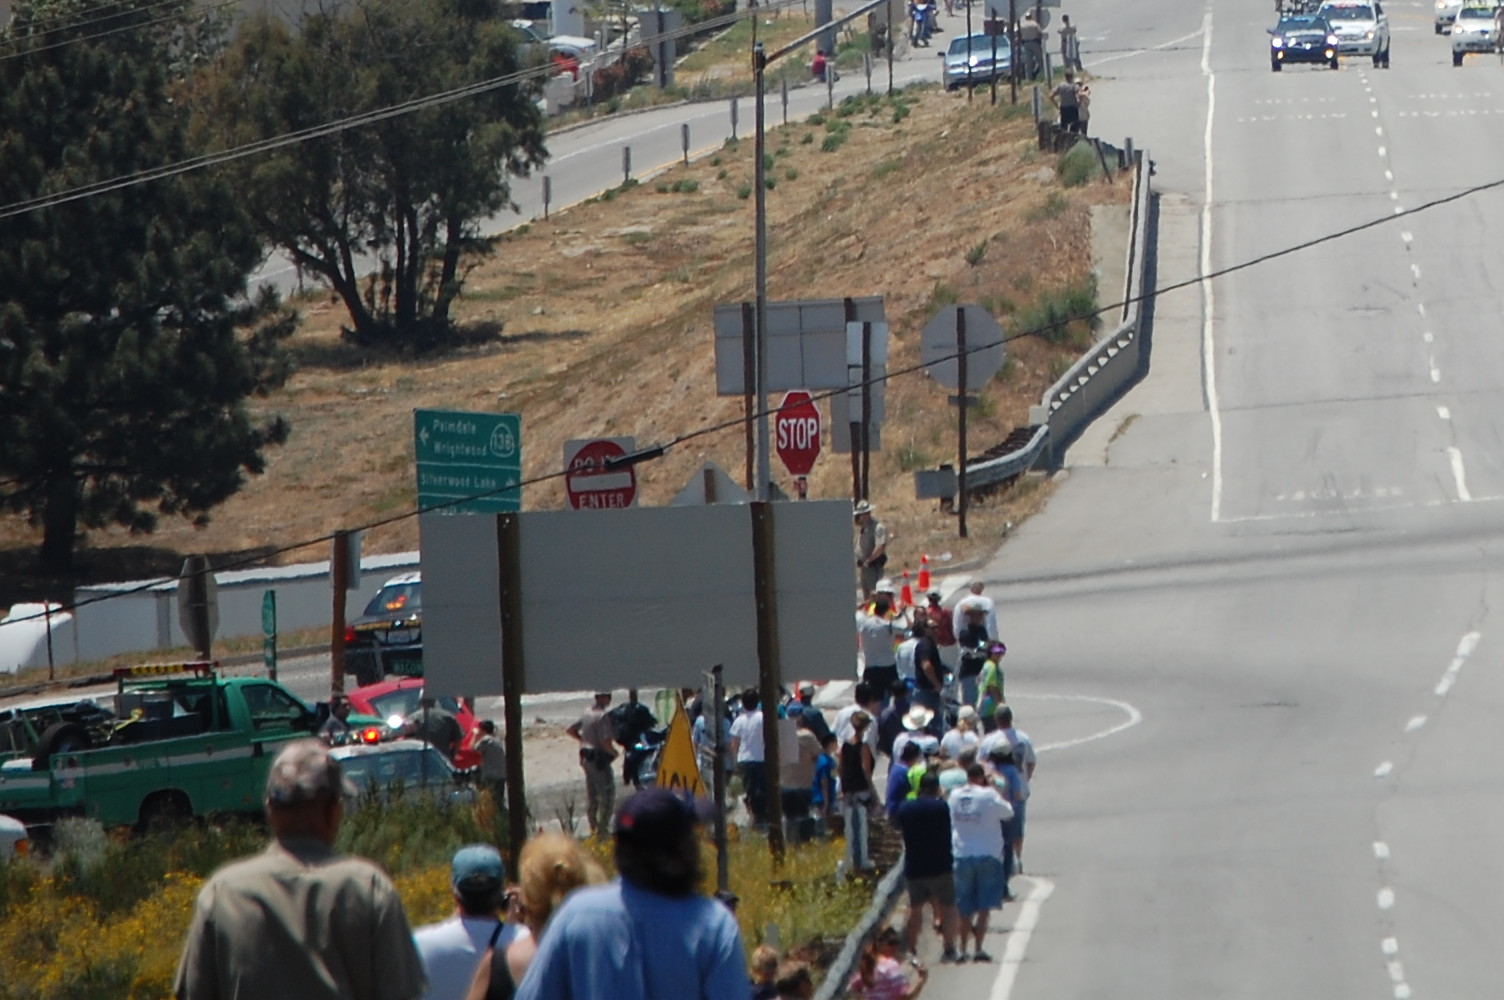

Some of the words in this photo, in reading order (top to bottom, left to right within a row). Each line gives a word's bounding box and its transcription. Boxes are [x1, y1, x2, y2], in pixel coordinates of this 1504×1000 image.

[433, 419, 477, 435] Palmdale
[778, 418, 818, 450] STOP
[433, 441, 488, 458] Wrightwood
[493, 433, 513, 451] 138
[575, 457, 594, 474] DO
[474, 476, 496, 489] Lake
[578, 493, 625, 511] ENTER
